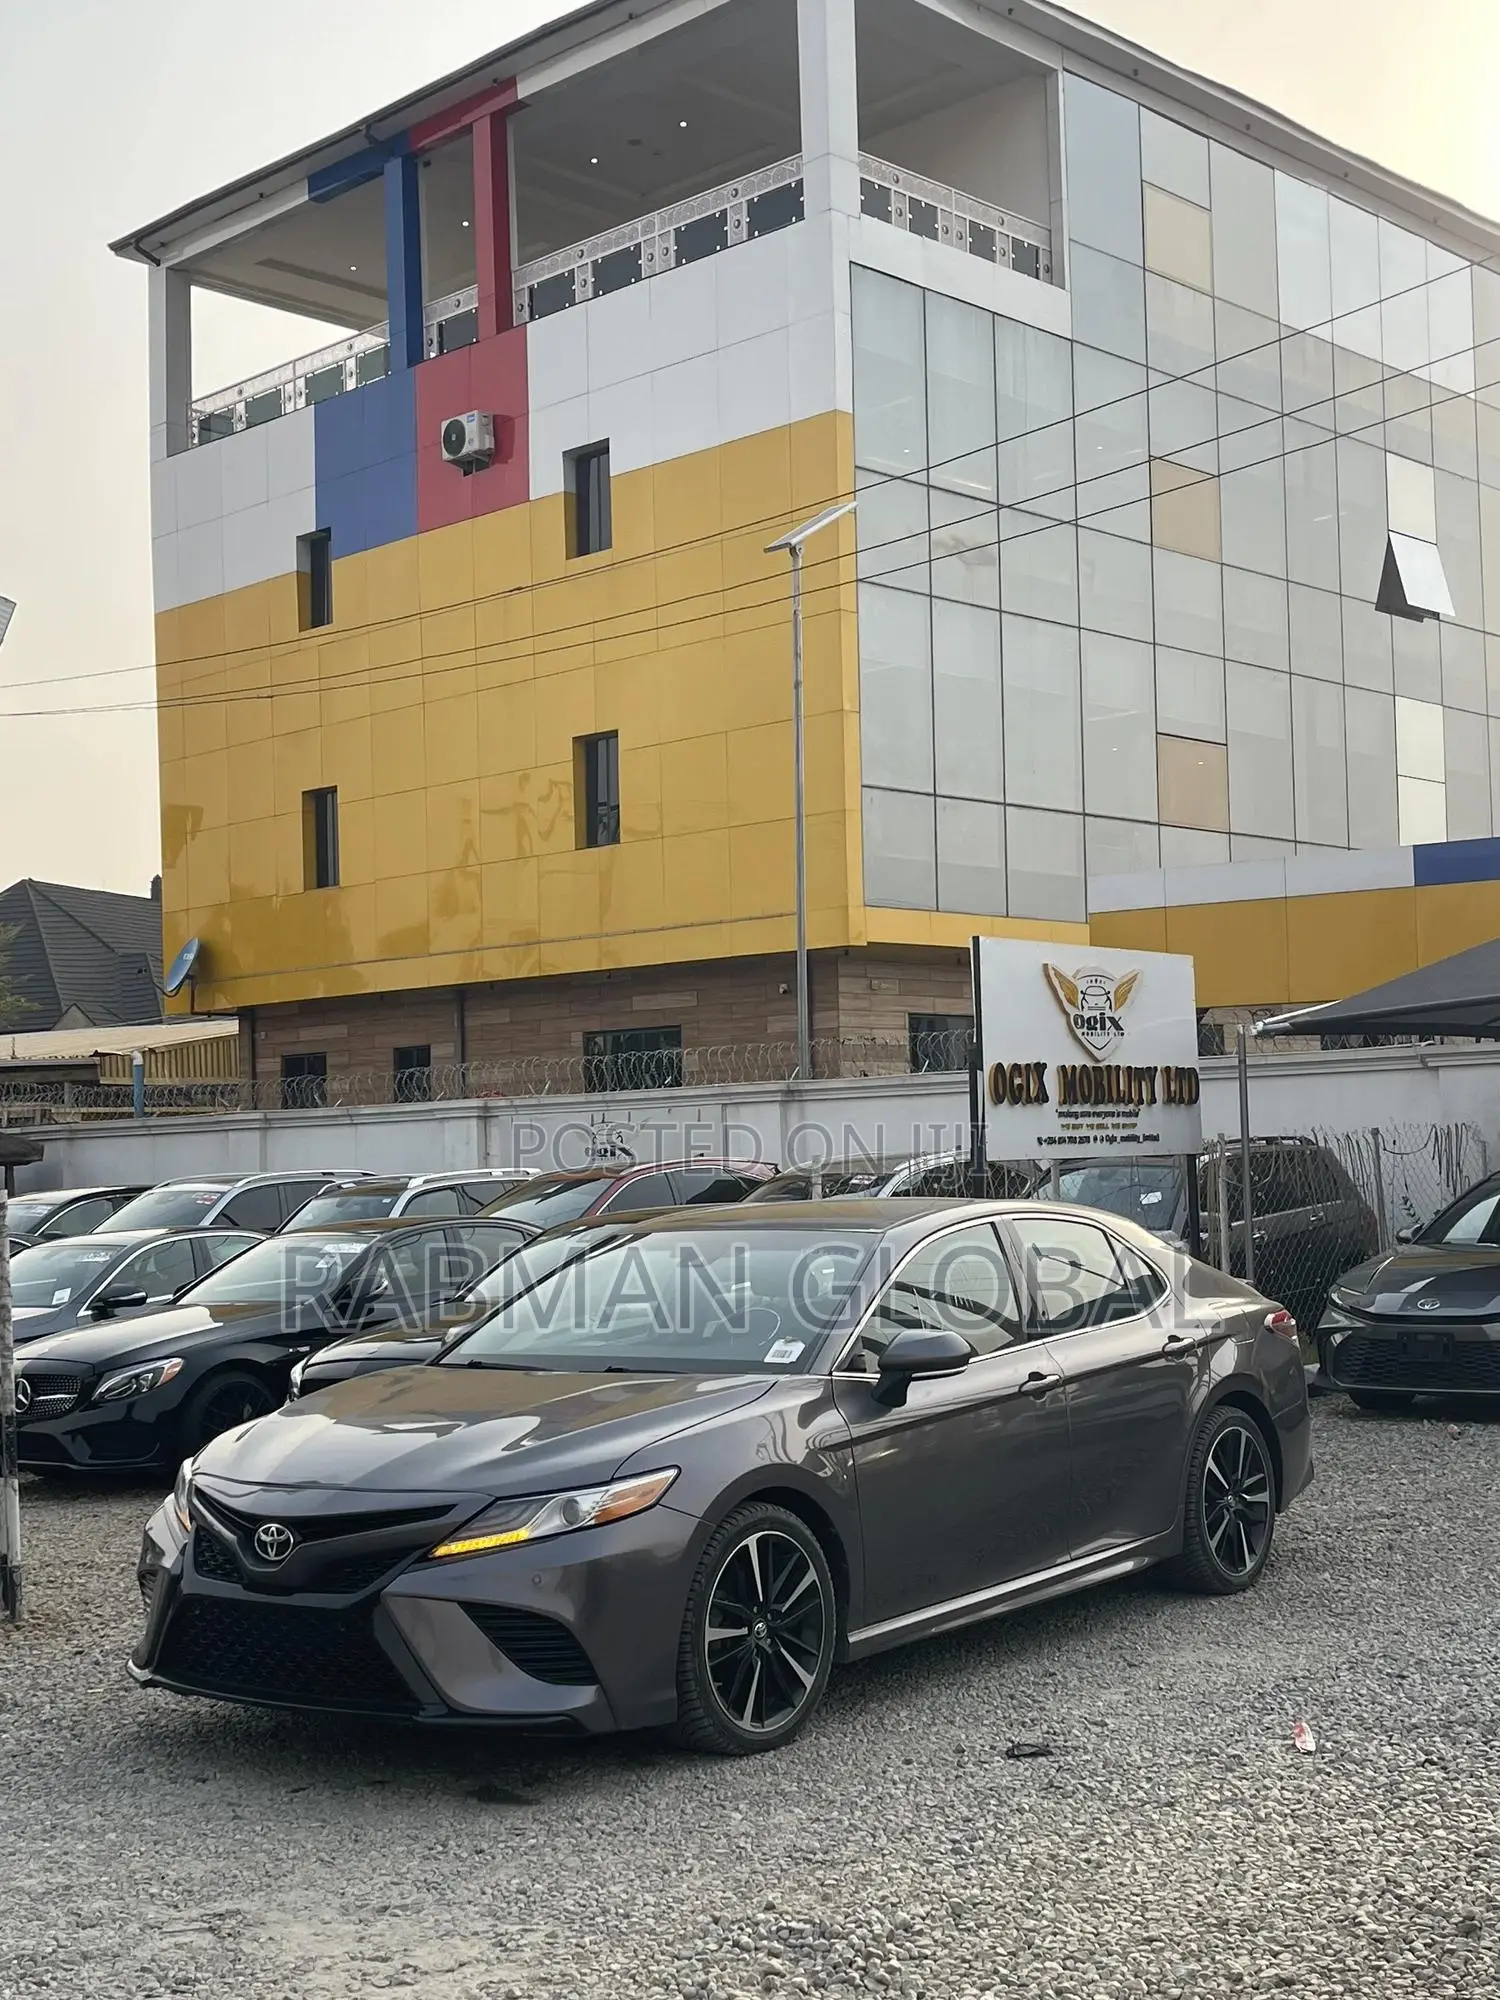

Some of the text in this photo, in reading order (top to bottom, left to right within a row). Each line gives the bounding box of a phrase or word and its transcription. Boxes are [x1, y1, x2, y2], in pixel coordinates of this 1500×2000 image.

[988, 1062, 1199, 1105] OGIX MOBILITY LTD
